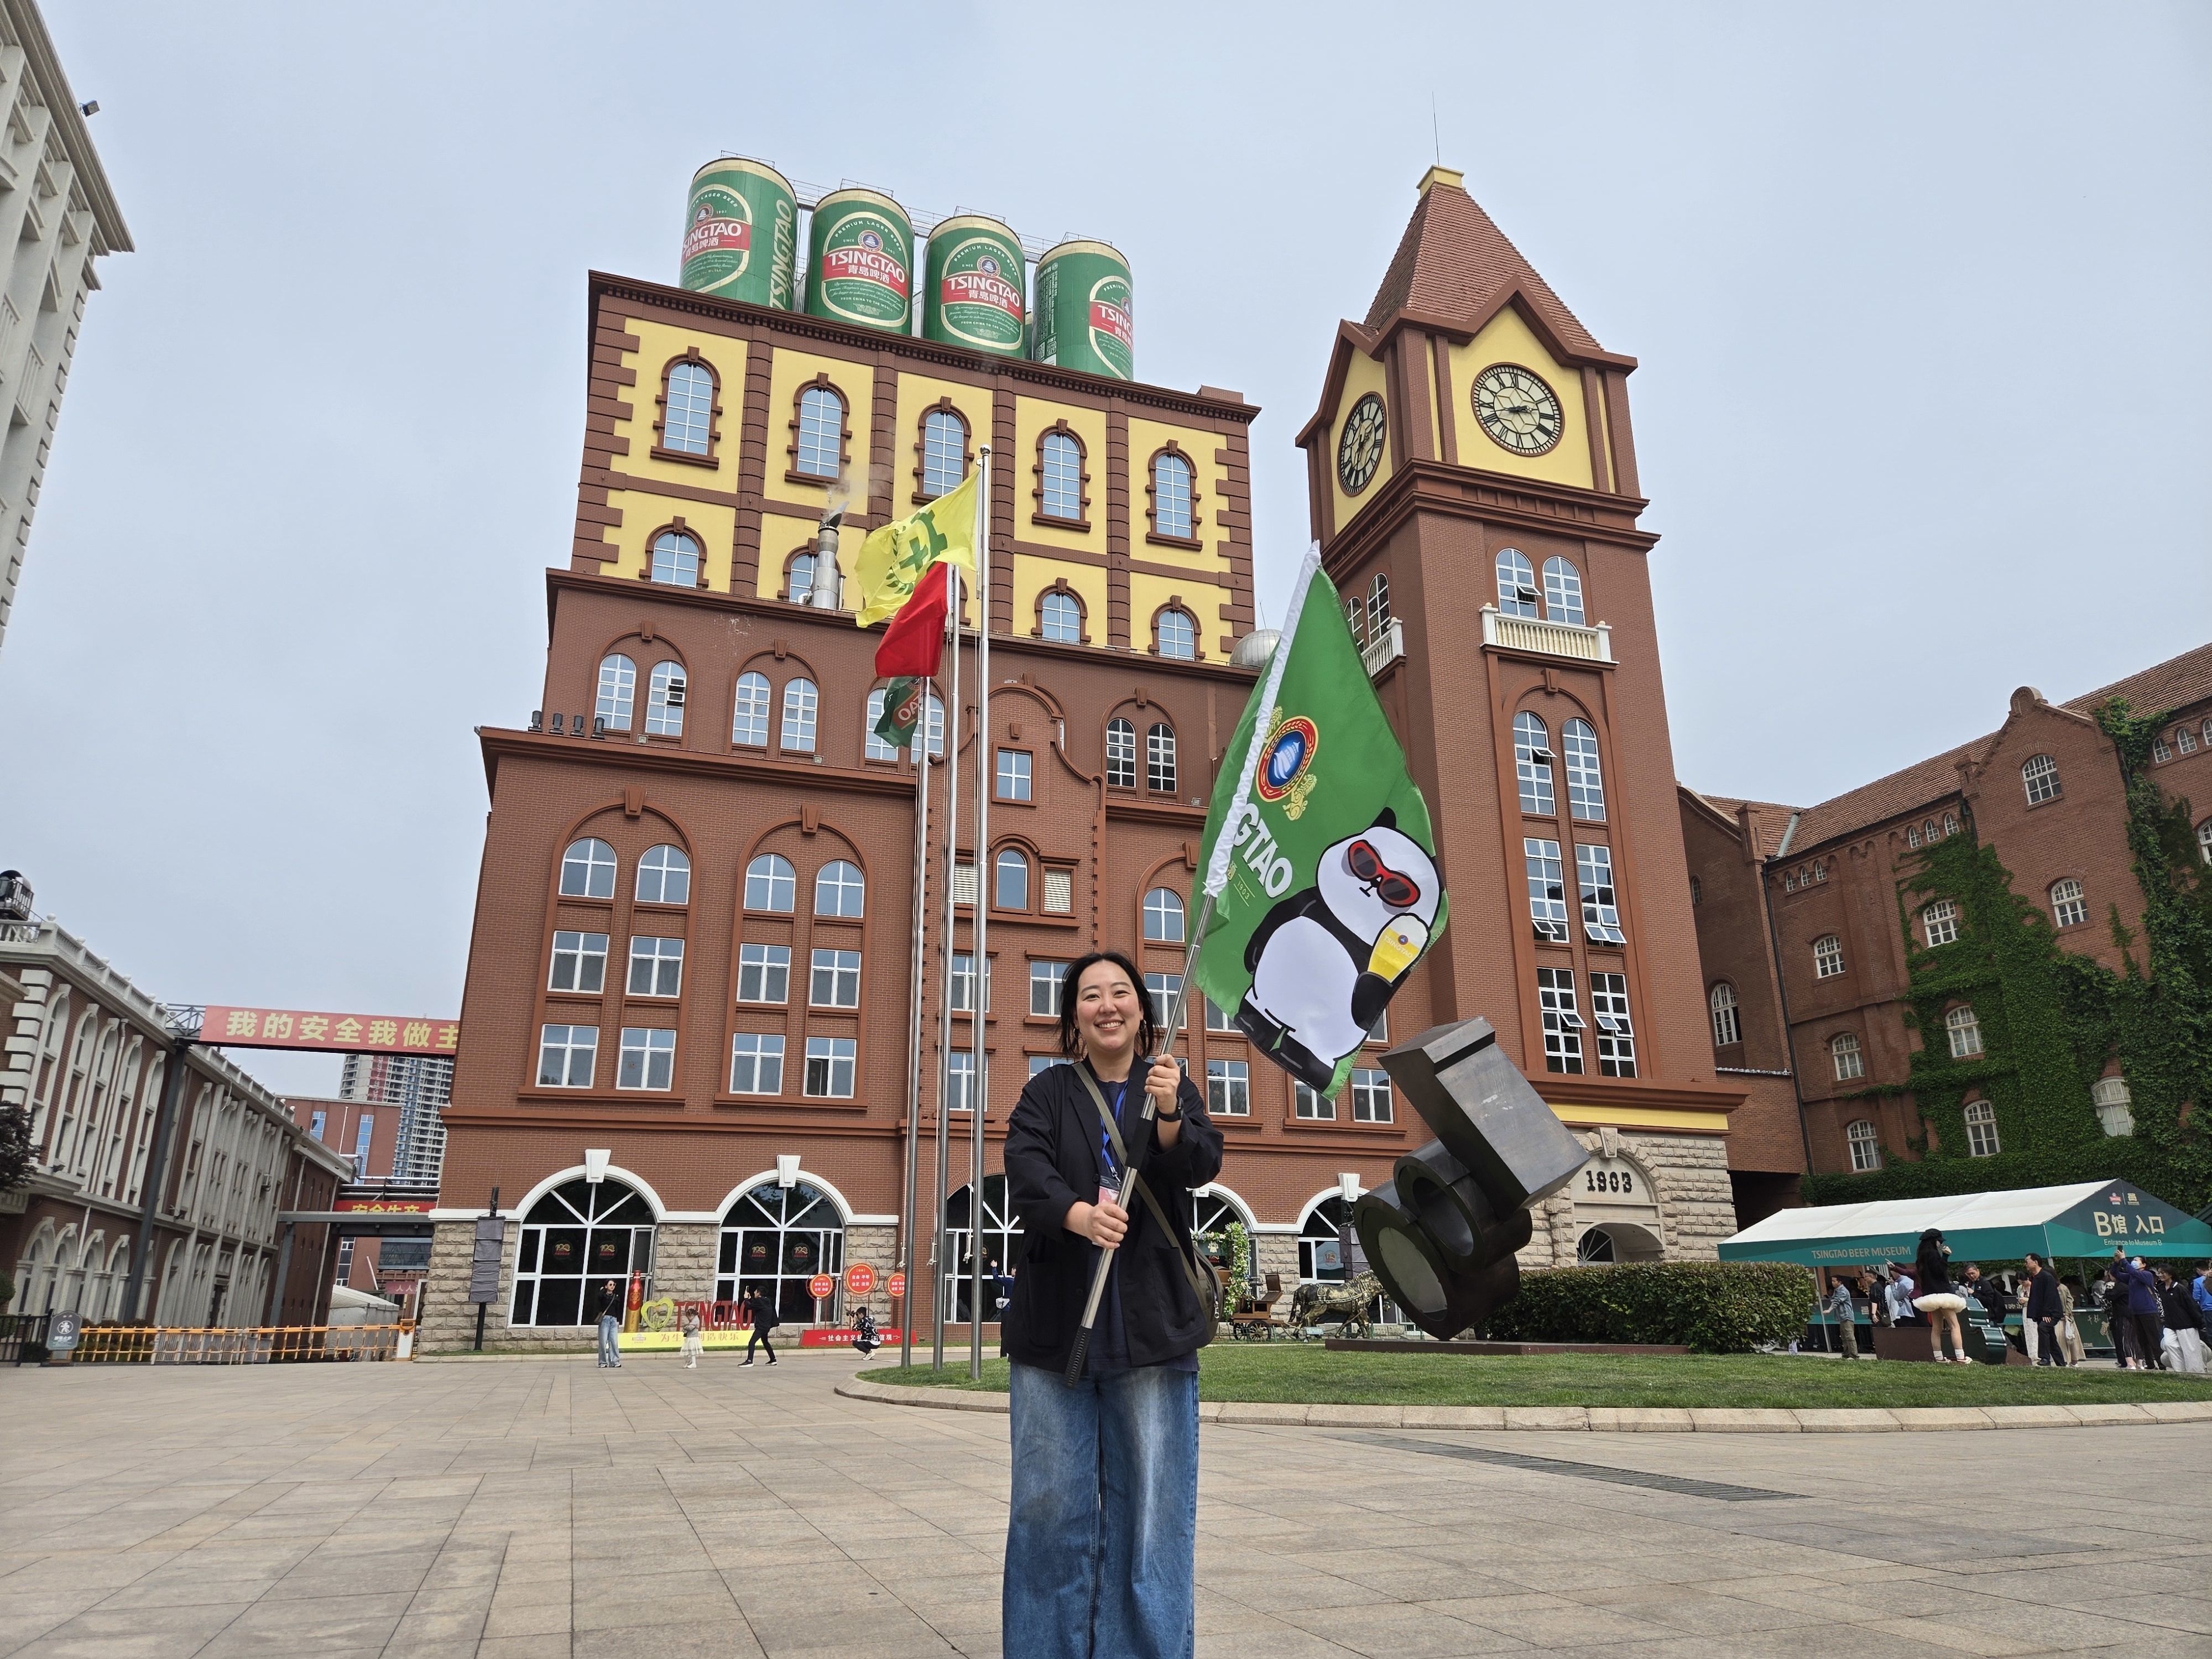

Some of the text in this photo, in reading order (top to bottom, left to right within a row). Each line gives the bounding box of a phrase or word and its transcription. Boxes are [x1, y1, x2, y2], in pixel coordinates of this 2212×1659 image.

[834, 221, 863, 238] PREMIUM
[867, 221, 889, 233] LAGER
[769, 199, 792, 310] TSINGTAO
[954, 245, 982, 262] PREMIUM
[984, 246, 1005, 258] LAGER
[828, 251, 905, 283] TSINGTAO
[947, 275, 1020, 307] TSINGTAO
[1103, 284, 1124, 292] PREMIUM
[1098, 305, 1133, 337] TSING
[1237, 880, 1250, 900] 1903
[1384, 935, 1413, 958] TSINGTAO
[226, 1010, 460, 1050] 我的安全我做主
[1585, 1170, 1632, 1193] 1903
[2093, 1212, 2165, 1237] B馆 入口
[1811, 1246, 1912, 1259] TSINGTAO BEER MUSEUM
[674, 1300, 752, 1332] TNGTAO
[661, 1332, 739, 1342] 为生造快乐
